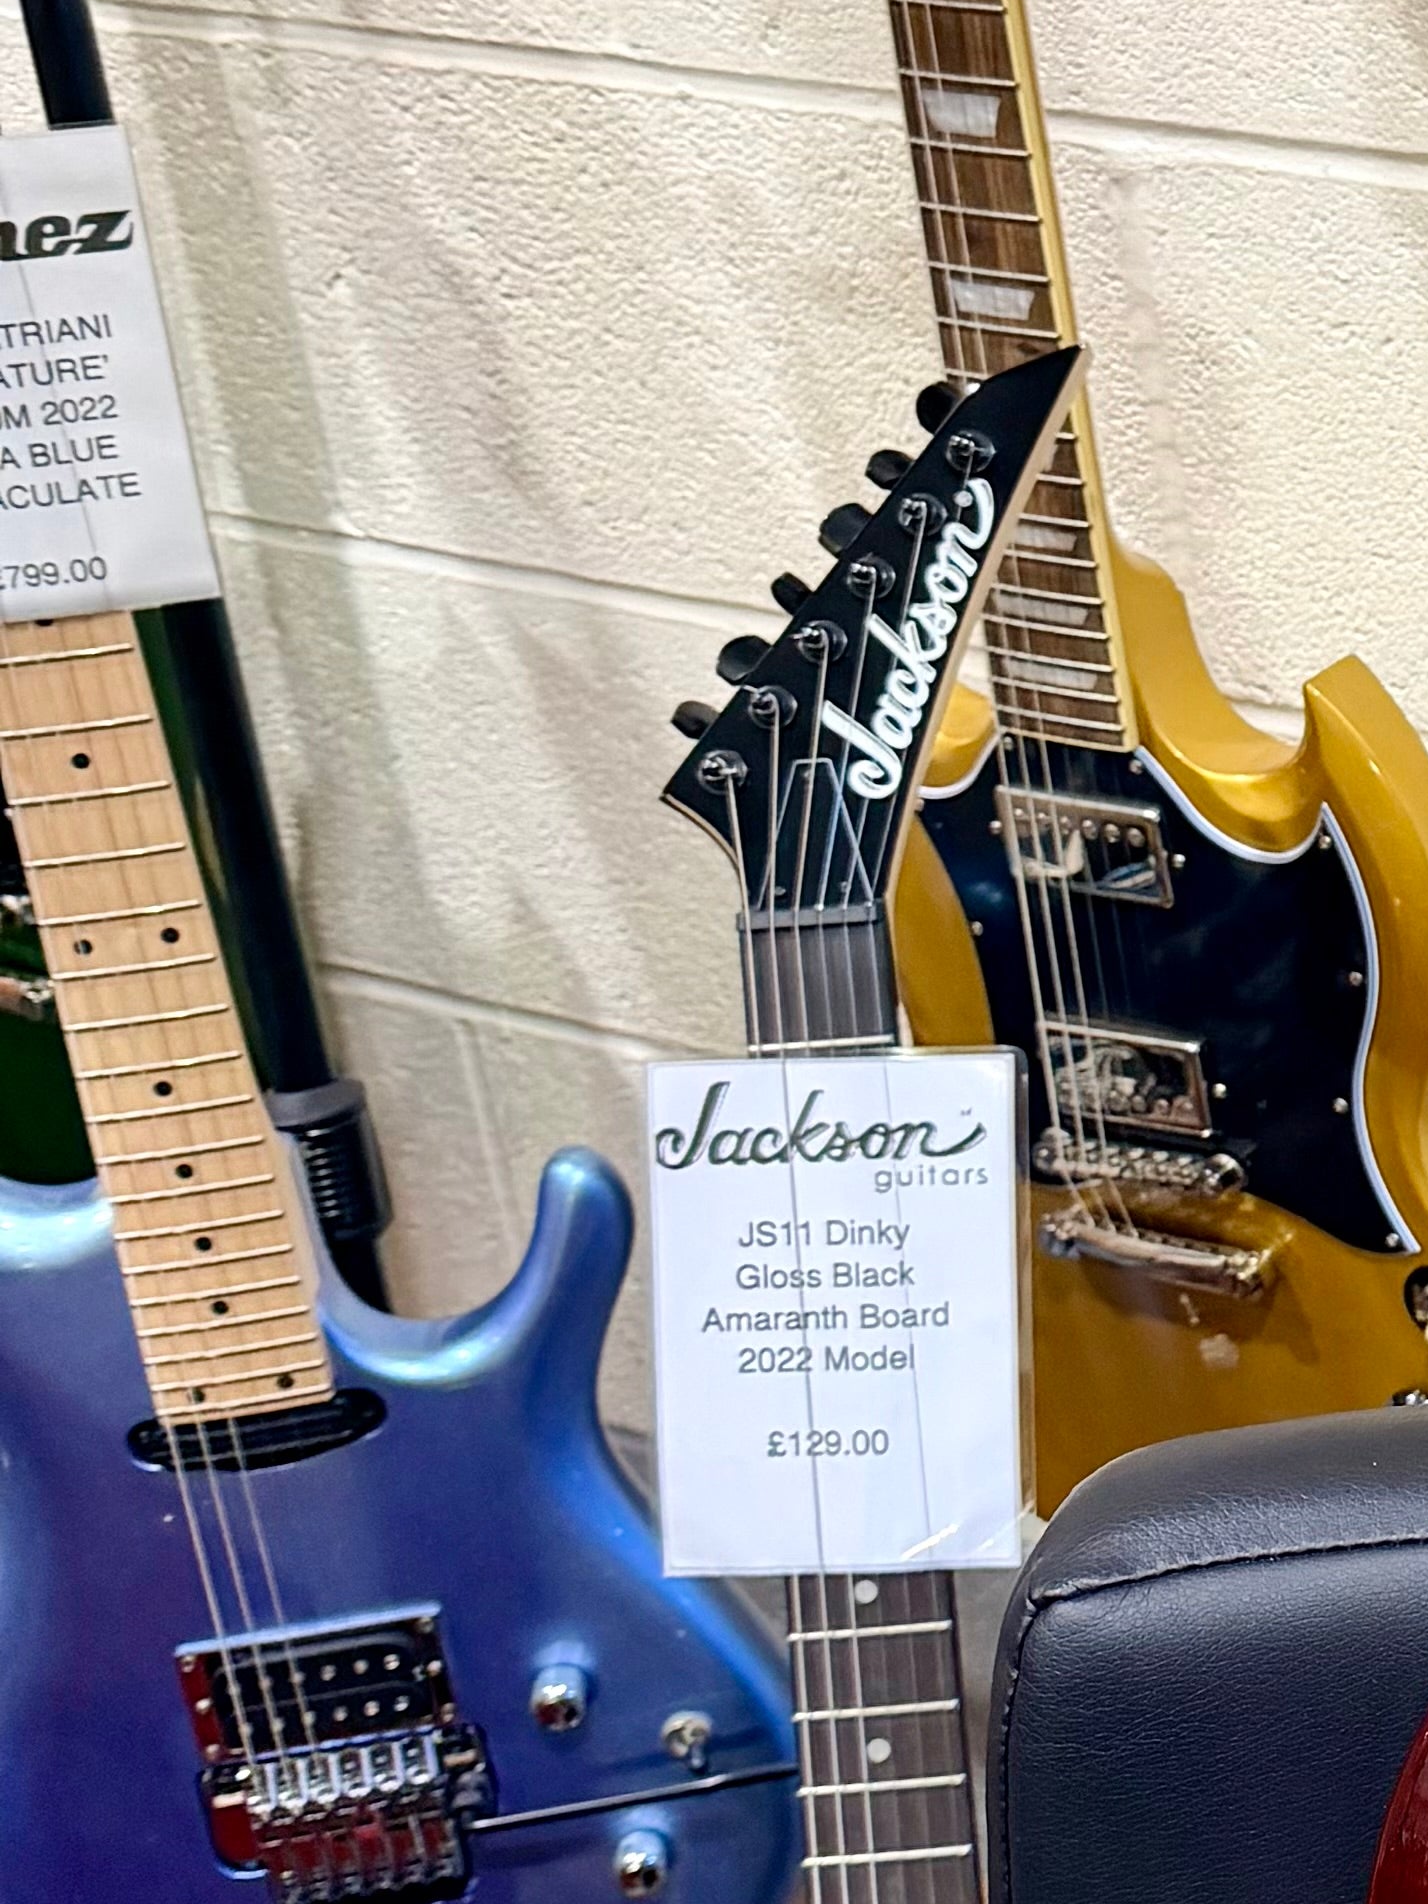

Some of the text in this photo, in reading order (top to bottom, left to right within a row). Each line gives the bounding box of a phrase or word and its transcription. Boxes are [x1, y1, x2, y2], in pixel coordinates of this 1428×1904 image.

[0, 314, 113, 349] TRIANI
[41, 394, 119, 425] 2022
[28, 434, 119, 467] BLUE
[822, 478, 995, 800] Jackson
[655, 1081, 988, 1171] Jackson
[874, 1165, 990, 1194] guitars
[738, 1219, 911, 1251] JS11 Dinky
[736, 1260, 915, 1290] Gloss Black
[701, 1301, 950, 1334] Amaranth Board
[738, 1344, 916, 1375] 2022 Model
[767, 1428, 890, 1458] £129.00
